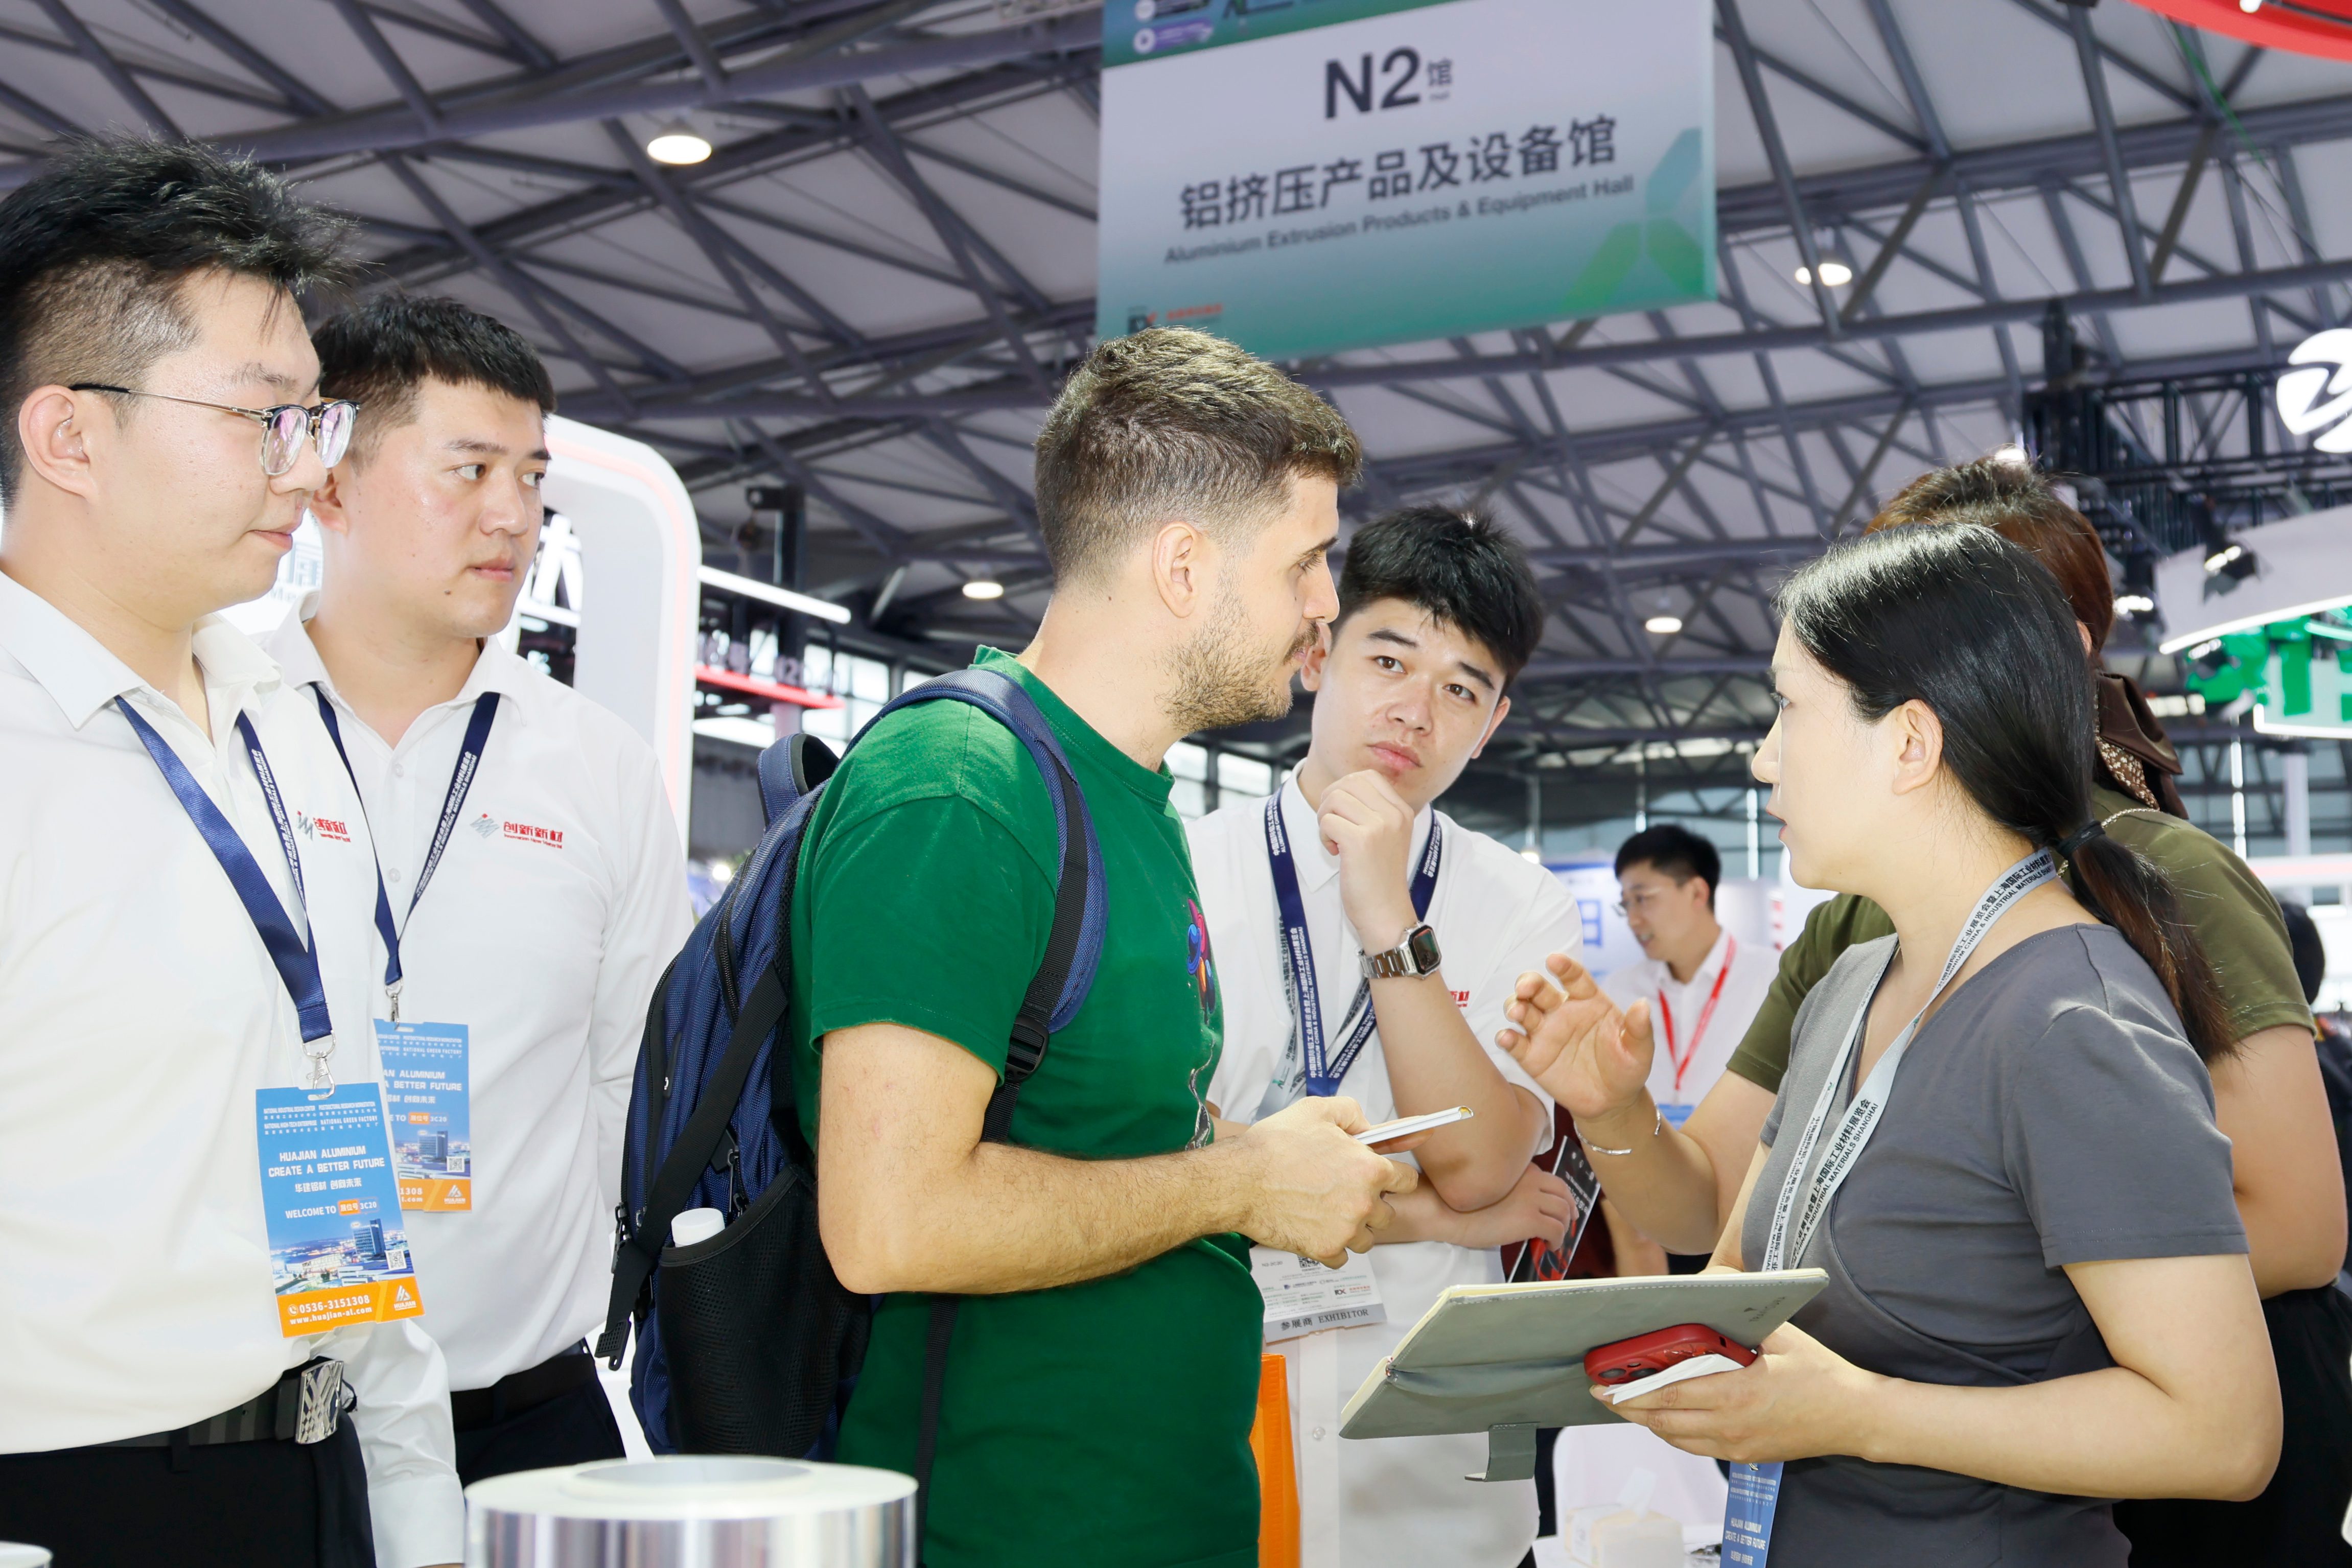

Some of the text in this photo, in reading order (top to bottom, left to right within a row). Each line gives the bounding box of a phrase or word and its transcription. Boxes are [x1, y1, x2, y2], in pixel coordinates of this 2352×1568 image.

[1427, 57, 1453, 87] 馆
[1324, 46, 1420, 120] N2
[1180, 113, 1617, 229] 铝挤压产品及设备馆
[1163, 174, 1634, 264] Aluminium Extrusion Products & Equipment Hall
[504, 821, 563, 842] 创新新材
[1964, 929, 1982, 950] CHINA
[1984, 888, 2018, 923] INDUSTRIAL
[2016, 872, 2042, 891] MATERIALS
[1297, 926, 1308, 954] SHANGHAI
[1303, 954, 1313, 986] MATERIALS
[1309, 986, 1317, 1020] INDUSTRIAL
[1315, 1044, 1323, 1078] ALUMINIUM
[399, 1070, 446, 1079] ALUMINIUM
[394, 1081, 426, 1089] BETTER
[430, 1083, 462, 1091] FUTURE
[280, 1145, 366, 1162] HUAJIAN ALUMINIUM
[268, 1157, 385, 1178] CREATE A BETTER FUTURE
[1809, 1183, 1832, 1226] INDUSTRIAL
[1829, 1142, 1856, 1183] MATERIALS
[1853, 1103, 1879, 1142] SHANGHAI
[295, 1177, 362, 1193] 华建铝材 创向未来
[285, 1206, 337, 1219] WELCOME TO
[360, 1201, 377, 1209] 3C20
[299, 1295, 370, 1314] 0536-3151308
[393, 1300, 416, 1309] HUAJIAN
[290, 1306, 372, 1325] www.huajian-al.com
[1281, 1318, 1313, 1331] 参展商
[1318, 1308, 1369, 1324] EXHIBITOR
